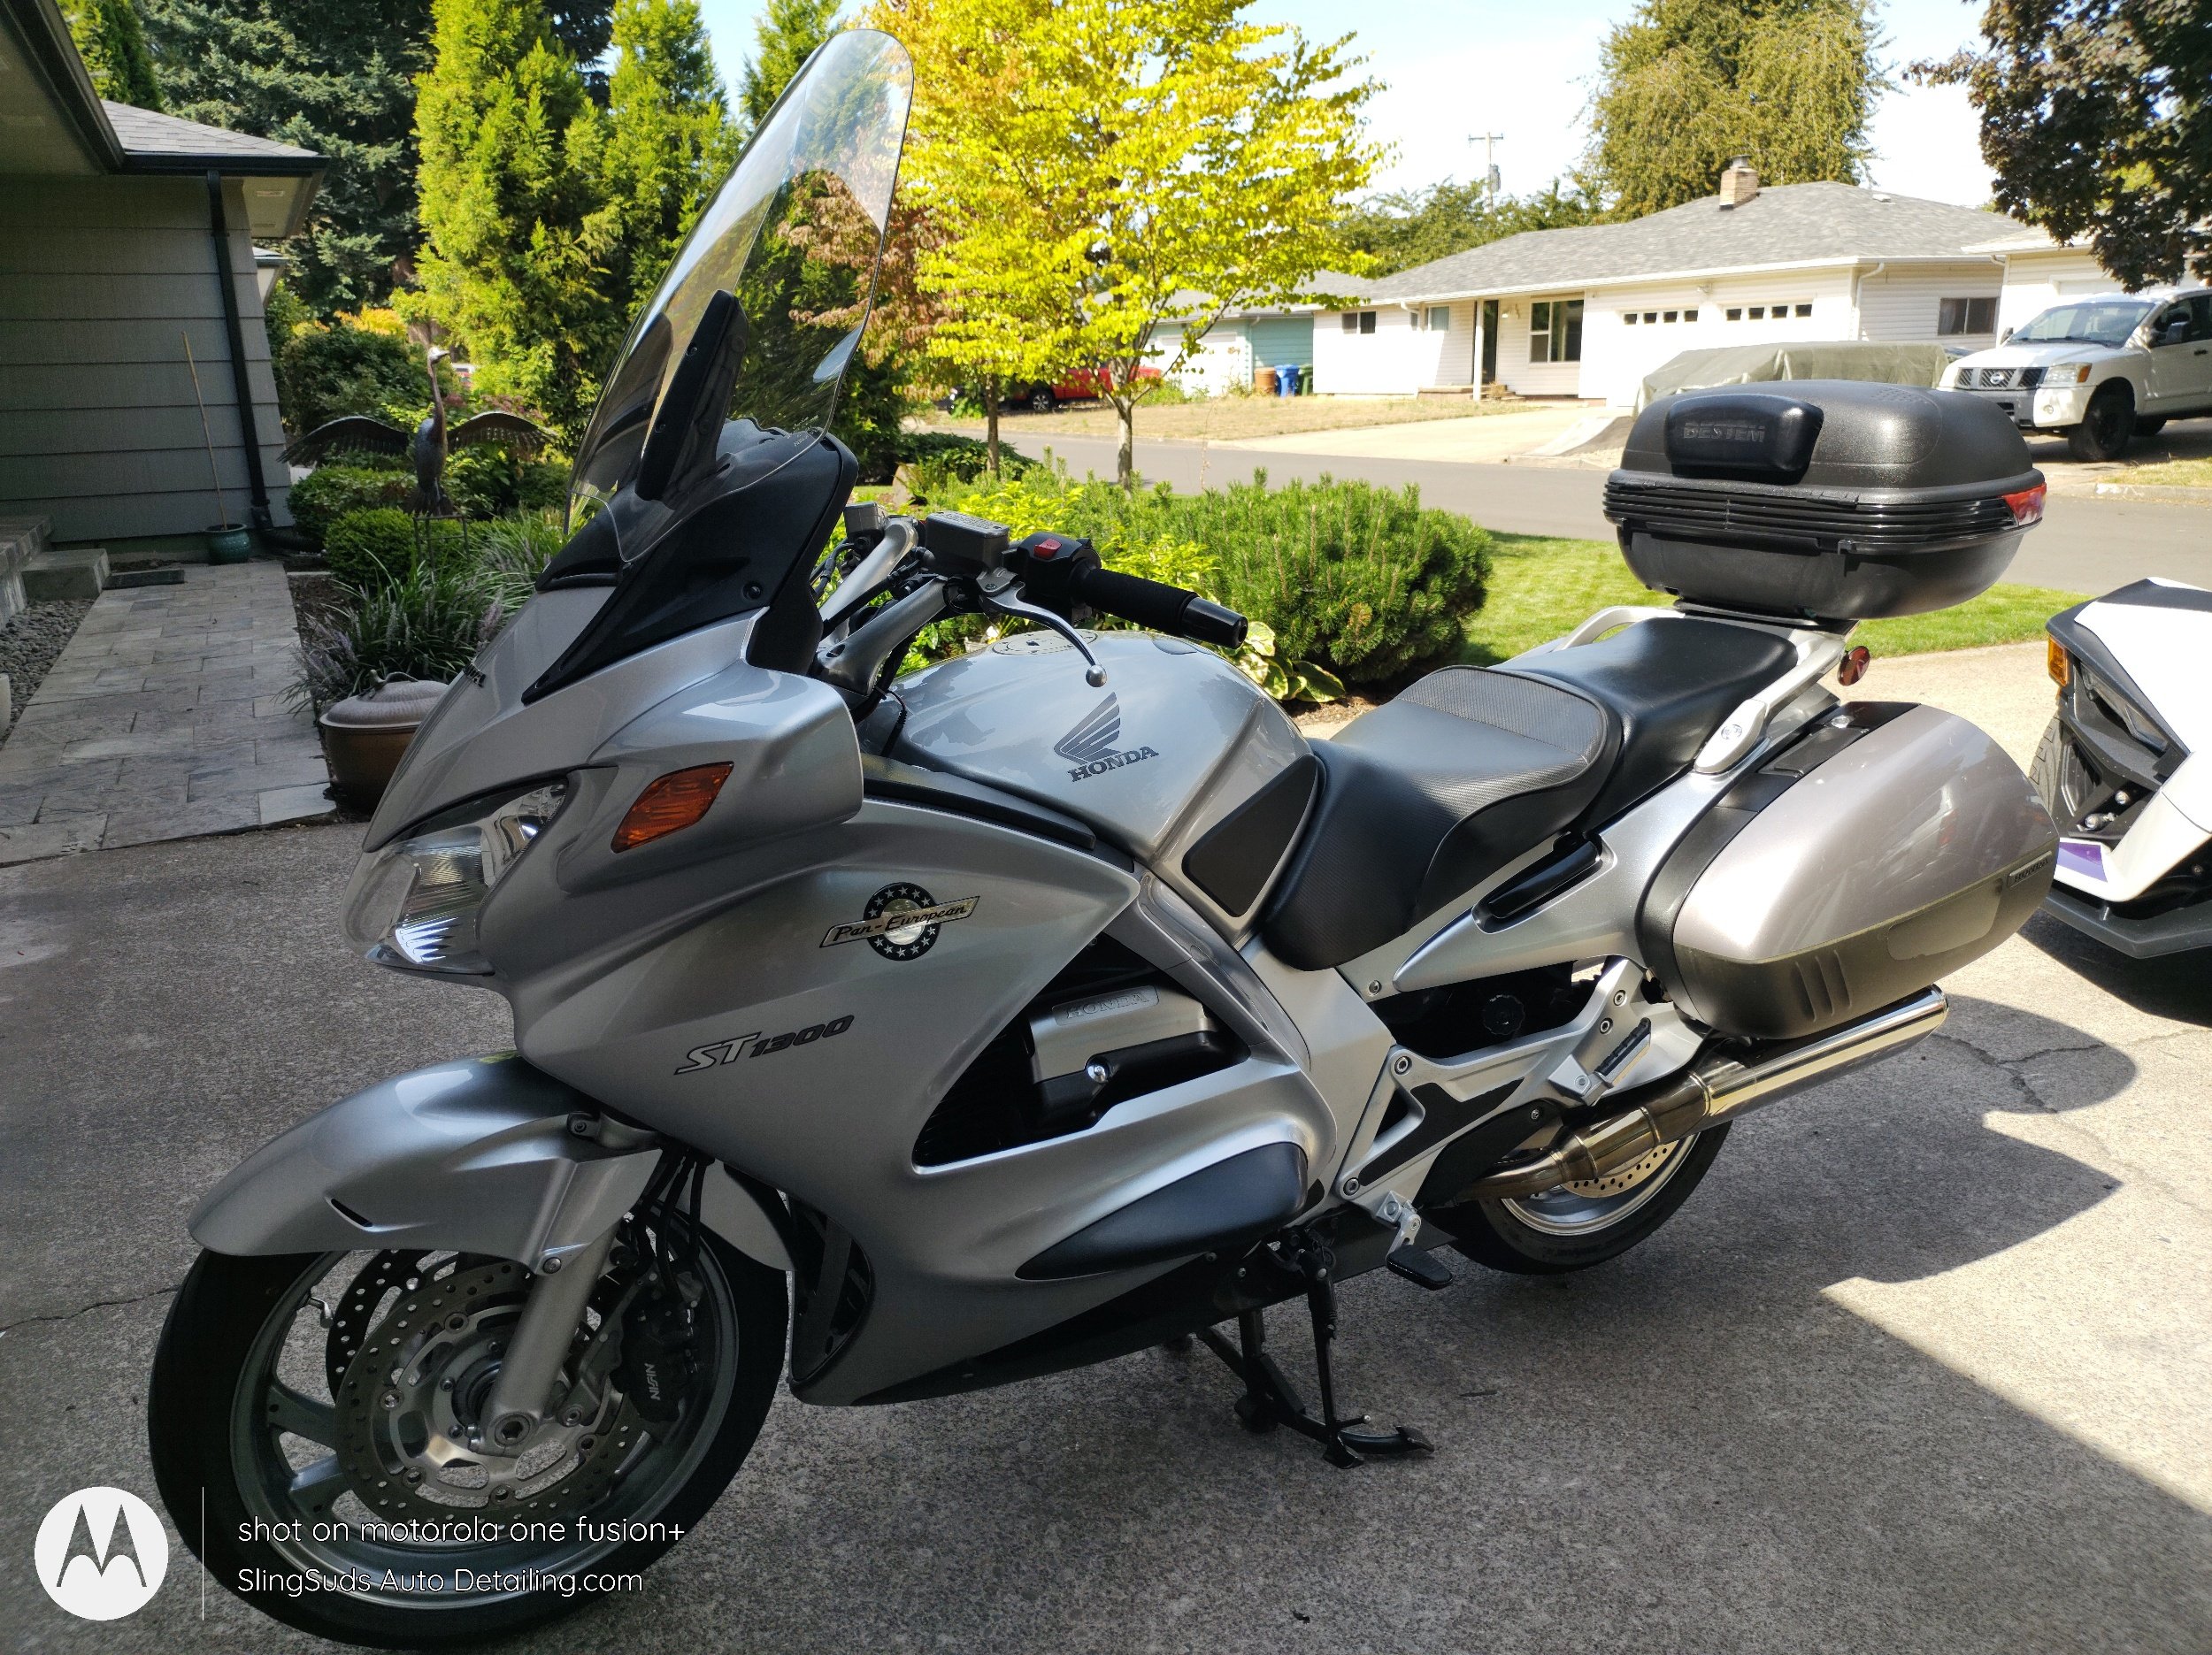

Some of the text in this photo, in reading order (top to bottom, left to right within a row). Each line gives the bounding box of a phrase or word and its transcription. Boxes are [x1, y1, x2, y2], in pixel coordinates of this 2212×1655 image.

[1684, 422, 1766, 442] BESTEM
[1067, 746, 1160, 783] HONDA
[833, 903, 967, 942] Pan-European
[1066, 991, 1150, 1019] HONDA
[672, 1014, 856, 1076] ST1300
